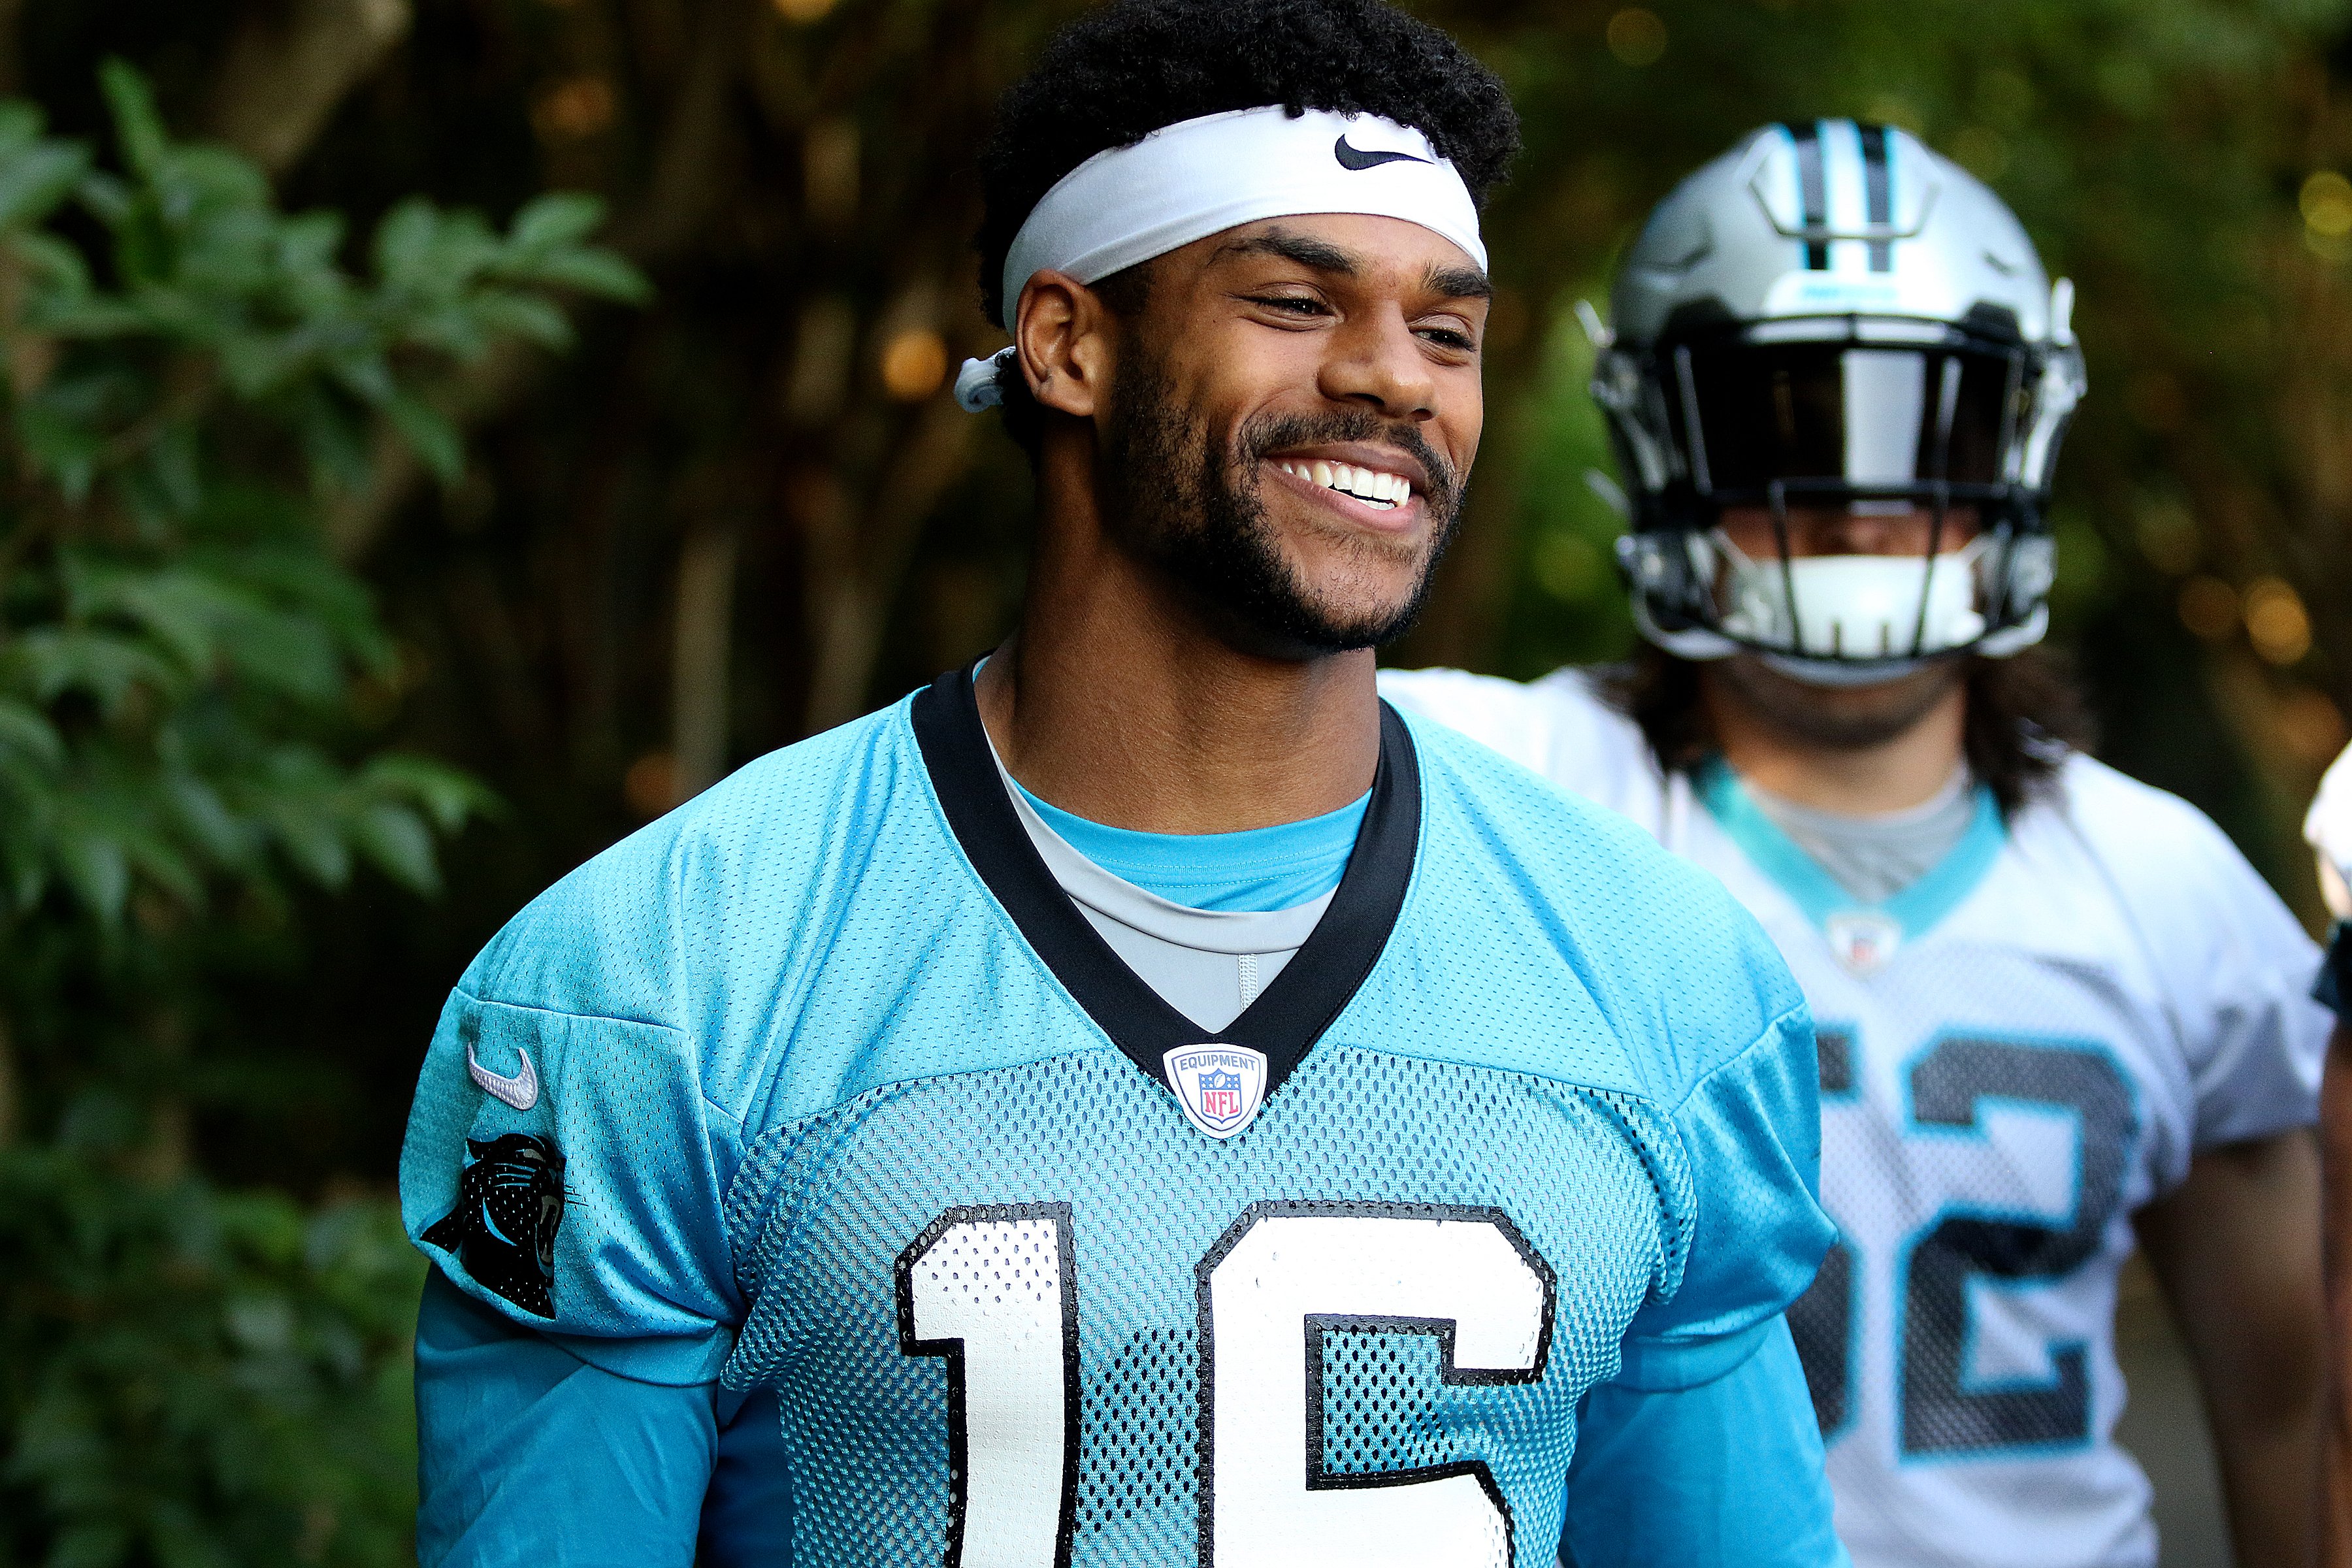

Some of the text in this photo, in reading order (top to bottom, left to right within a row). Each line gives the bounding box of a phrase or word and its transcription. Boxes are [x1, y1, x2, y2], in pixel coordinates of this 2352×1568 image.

[1180, 1054, 1256, 1071] EQUIPMENT
[1205, 1092, 1239, 1117] NFL
[896, 1200, 1558, 1568] 16
